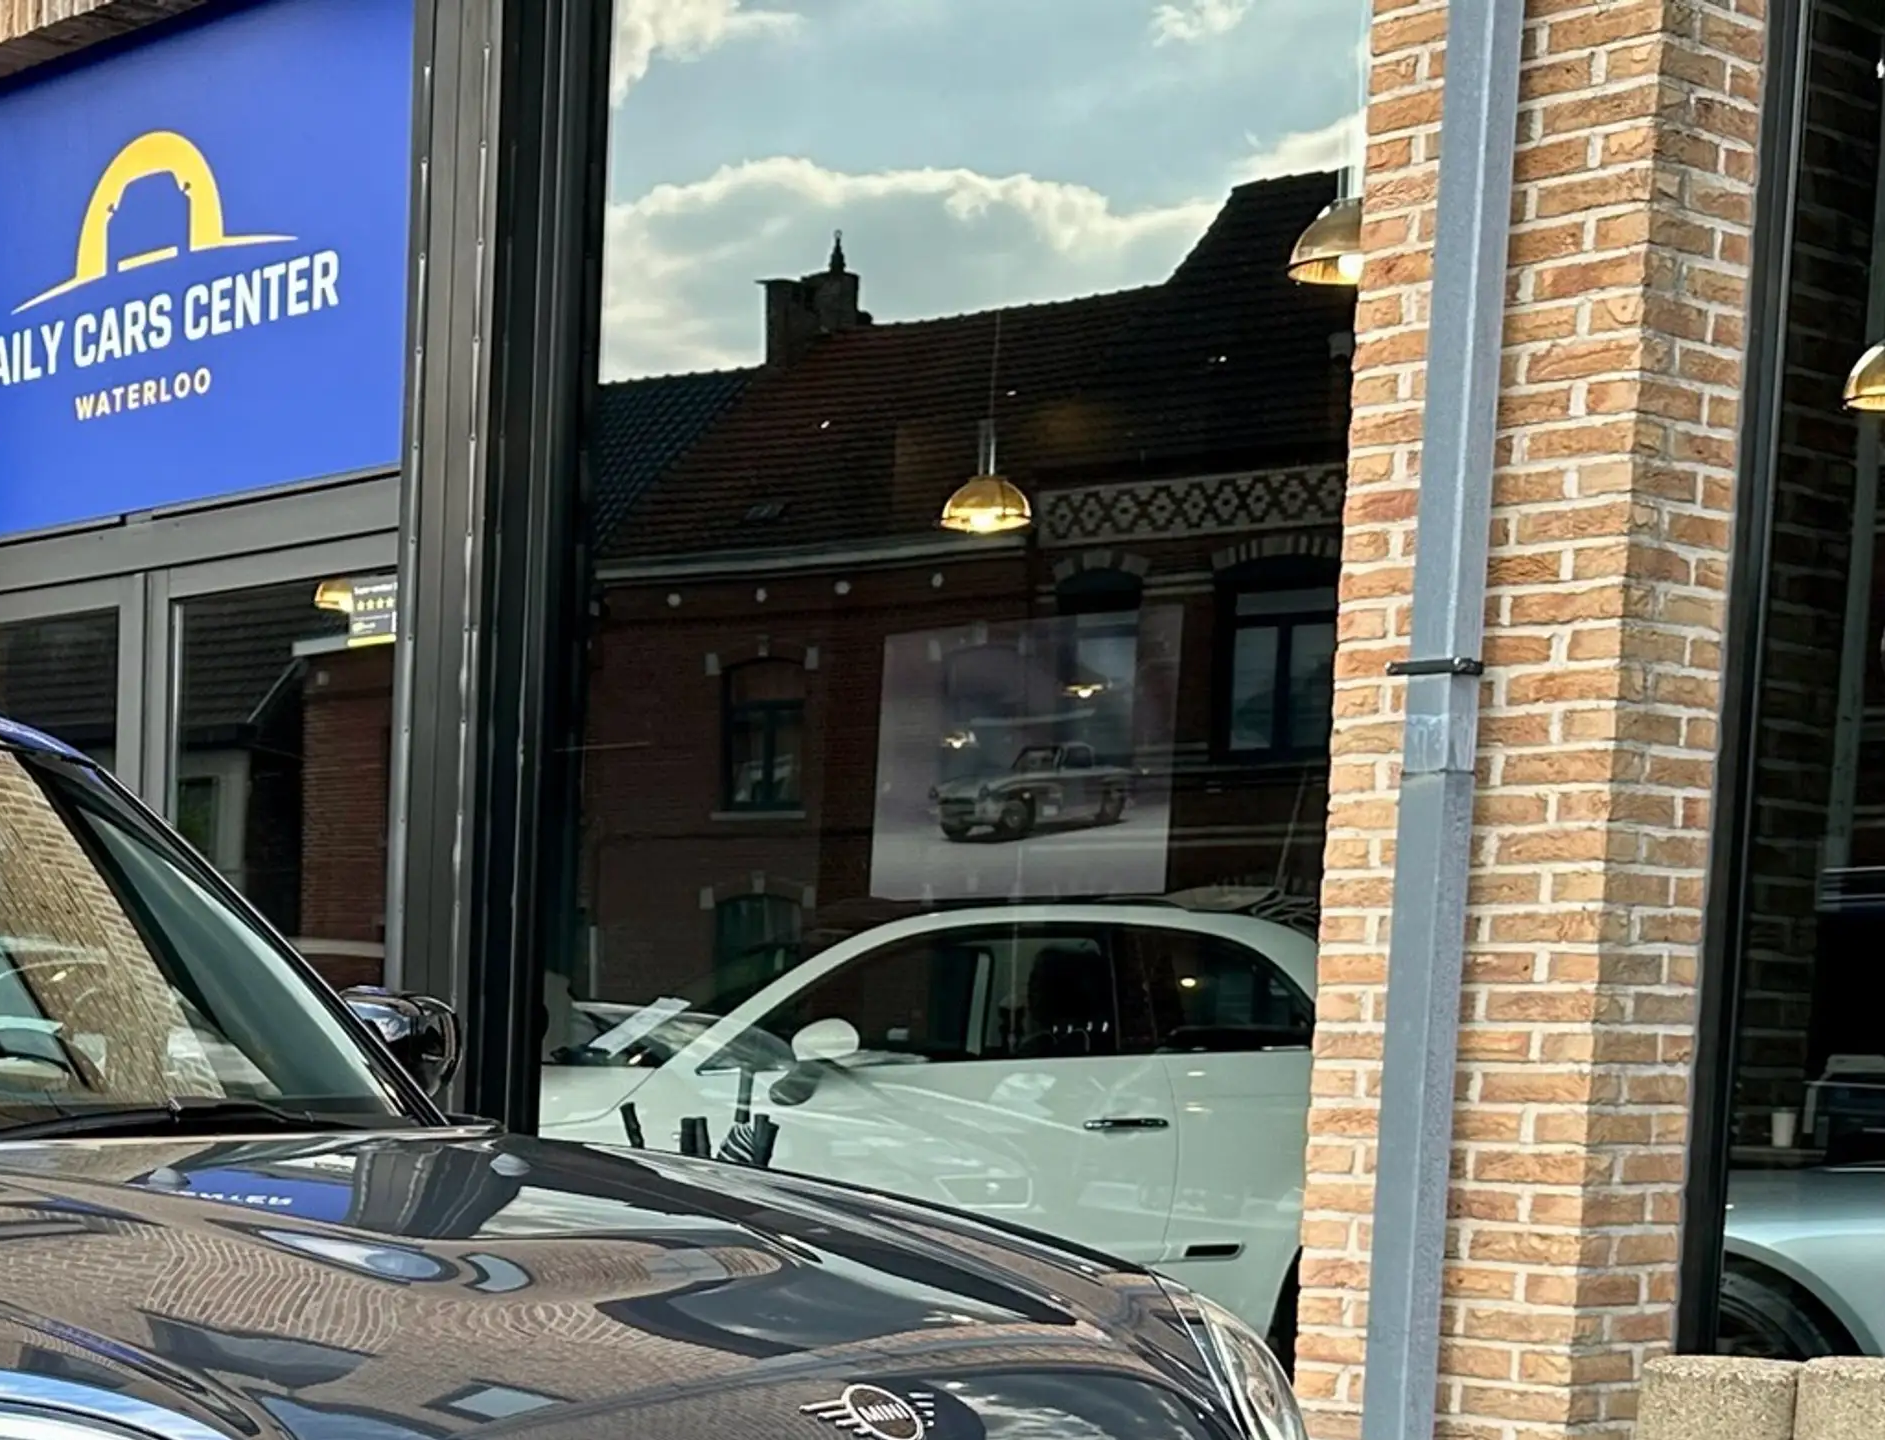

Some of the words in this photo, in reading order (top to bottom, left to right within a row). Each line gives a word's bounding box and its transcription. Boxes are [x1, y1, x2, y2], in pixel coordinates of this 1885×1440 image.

[73, 294, 172, 368] CARS
[184, 250, 339, 341] CENTER
[75, 367, 212, 421] WATERLOO
[856, 1402, 911, 1423] MINI
